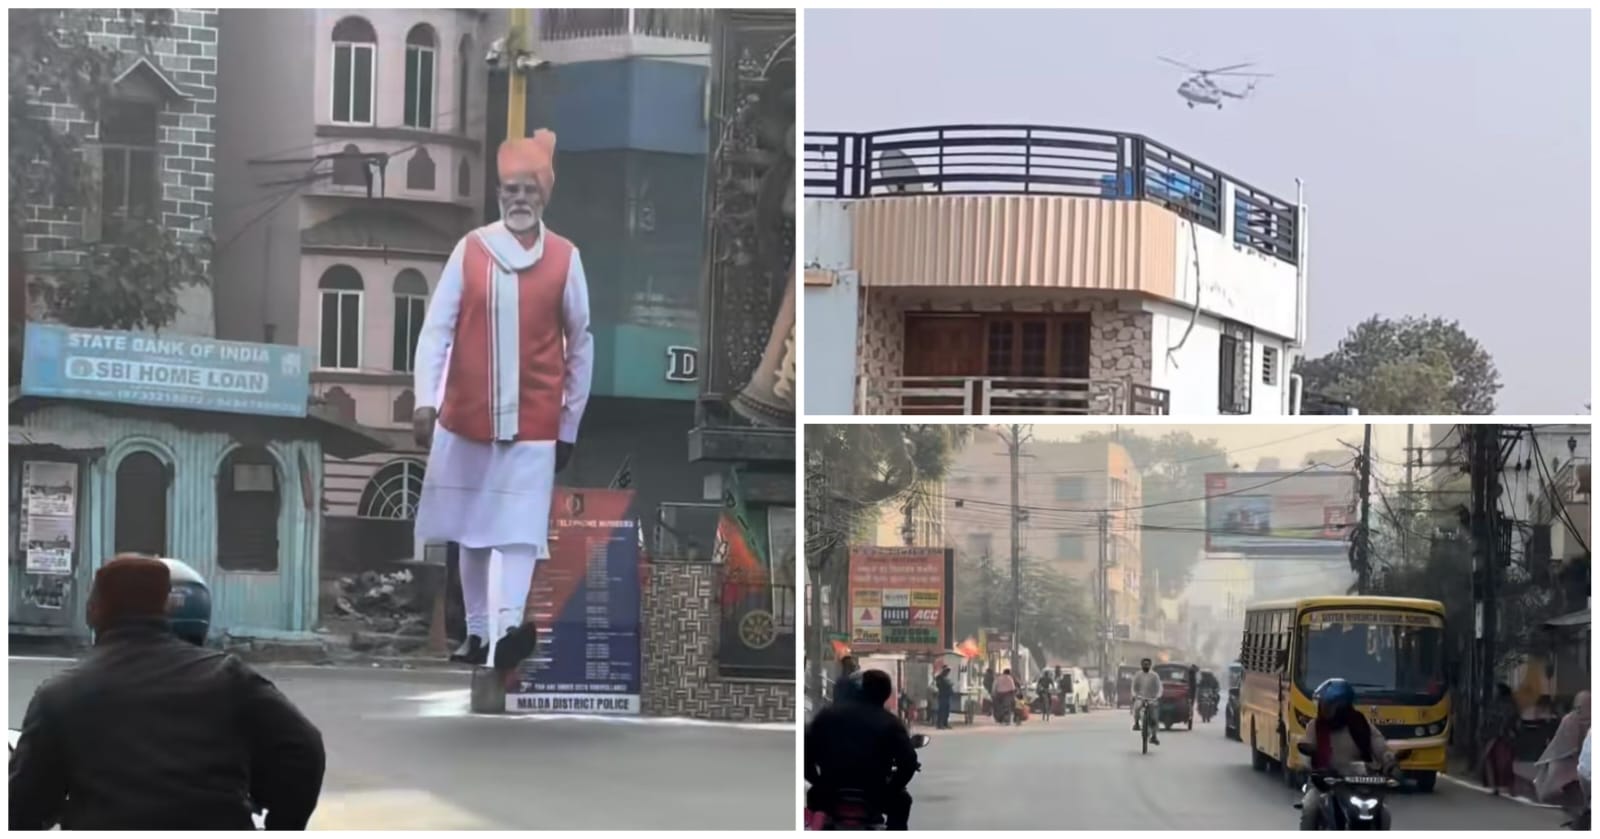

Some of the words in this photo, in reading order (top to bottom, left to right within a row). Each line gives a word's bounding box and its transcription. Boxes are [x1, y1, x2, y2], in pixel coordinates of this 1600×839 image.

[68, 333, 127, 351] STATE
[132, 338, 185, 356] BANK
[190, 343, 215, 358] OF
[219, 345, 270, 362] INDIA
[95, 361, 131, 379] SBI
[138, 365, 202, 387] HOME
[207, 370, 264, 391] LOAN
[914, 609, 938, 620] ACC
[517, 697, 551, 710] MALDA
[553, 697, 594, 710] DISTRICT
[597, 697, 630, 711] POLICE
